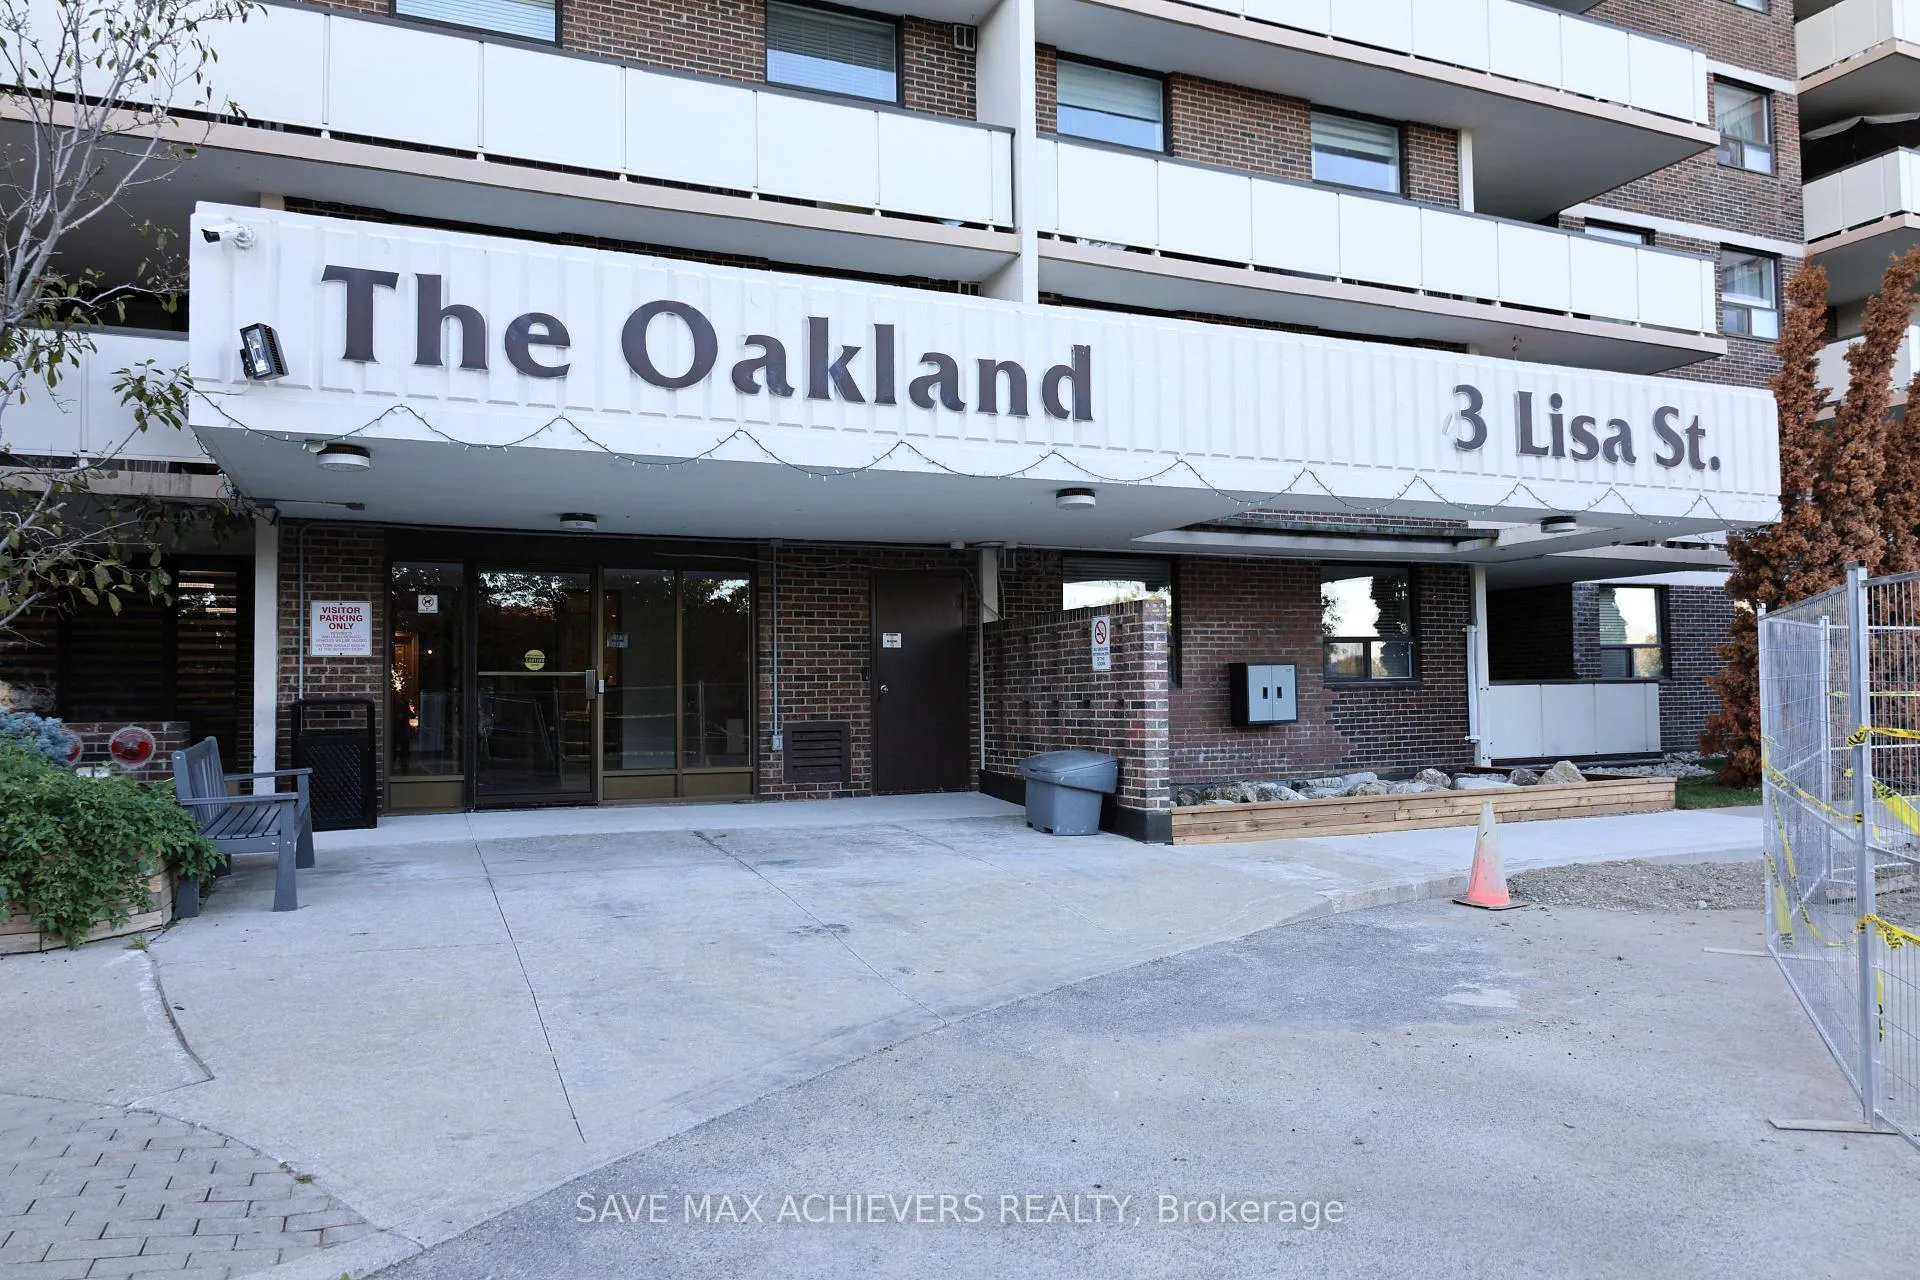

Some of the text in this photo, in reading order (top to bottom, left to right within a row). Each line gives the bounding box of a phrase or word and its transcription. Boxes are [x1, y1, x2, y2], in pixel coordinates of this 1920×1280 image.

[321, 264, 1094, 422] The Oakland
[1452, 384, 1721, 471] 3 Lisa St.
[321, 606, 361, 614] VISITOR
[328, 622, 354, 630] ONLY
